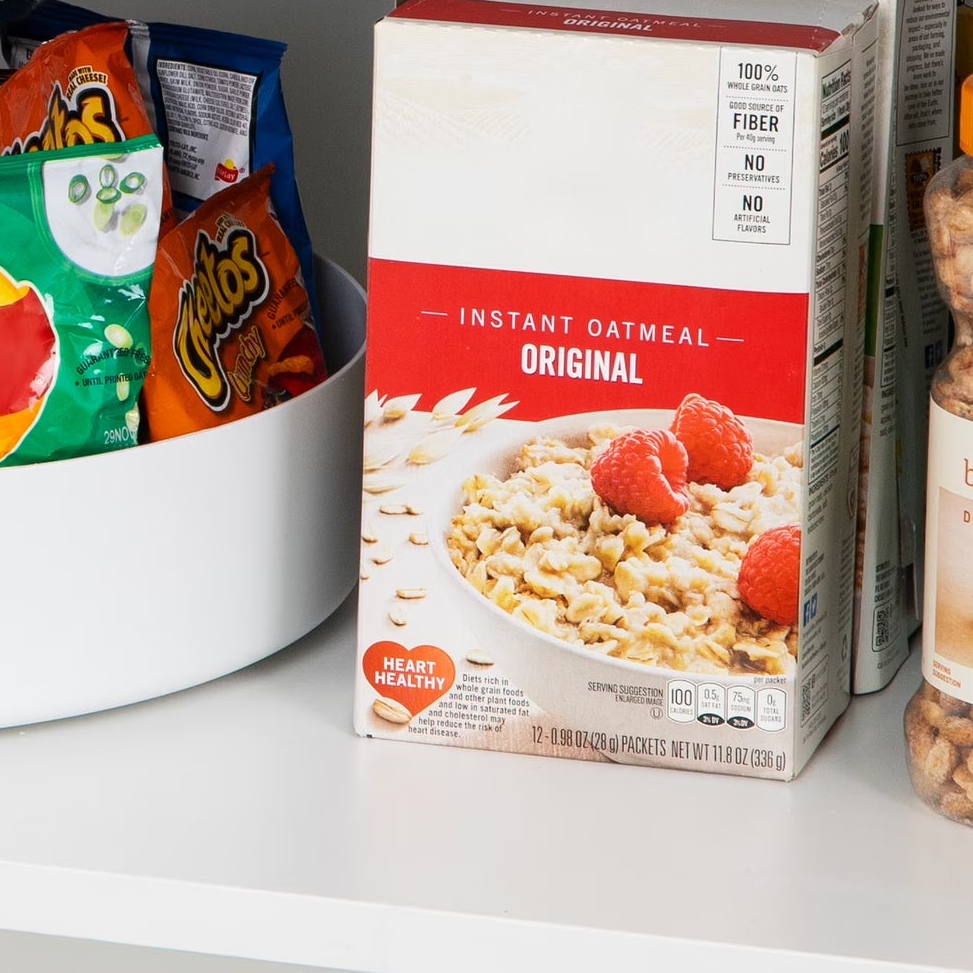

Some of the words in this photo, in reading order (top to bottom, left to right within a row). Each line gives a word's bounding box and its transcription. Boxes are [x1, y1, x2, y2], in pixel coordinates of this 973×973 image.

[528, 10, 611, 20] INSTANT
[617, 17, 703, 28] OATMEAL
[563, 18, 653, 32] ORIGINAL
[76, 72, 107, 86] CHEESE!
[738, 62, 779, 81] 100%
[727, 81, 749, 91] WHOLE
[750, 83, 771, 92] GRAIN
[772, 85, 788, 93] OATS
[729, 101, 747, 110] GOOD
[748, 102, 774, 112] SOURCE
[775, 104, 784, 113] OF
[733, 112, 779, 132] FIBER
[736, 132, 745, 141] Per
[746, 133, 756, 143] 40g
[757, 135, 775, 145] serving
[744, 153, 765, 171] NO
[727, 172, 780, 184] PRESERVATIVES
[742, 194, 763, 212] NO
[733, 213, 771, 224] ARTIFICIAL
[737, 224, 767, 234] FLAVORS
[175, 233, 266, 406] Cheetos
[459, 307, 574, 334] INSTANT
[587, 318, 710, 347] OATMEAL
[76, 347, 129, 375] GUARANTEED
[521, 343, 644, 385] ORIGINAL
[82, 377, 103, 387] UNTIL
[104, 374, 133, 384] PRINTED
[383, 656, 436, 675] HEART
[374, 671, 446, 691] HEALTHY
[462, 673, 482, 684] Diets
[484, 675, 499, 686] rich
[501, 677, 509, 686] in
[765, 675, 787, 685] packet
[932, 668, 962, 688] SUGGESTION
[455, 683, 479, 693] whole
[480, 685, 501, 696] grain
[502, 687, 524, 697] foods
[588, 681, 619, 694] SERVING
[619, 684, 664, 698] SUGGESTION
[704, 688, 720, 702] 0.5g
[449, 692, 463, 701] and
[464, 693, 485, 703] other
[487, 695, 507, 706] plant
[508, 697, 530, 708] foods
[615, 695, 645, 705] ENLARGED
[645, 697, 664, 707] IMAGE
[671, 688, 692, 707] 100
[732, 691, 750, 704] 75mg
[766, 693, 776, 707] 0g
[439, 701, 453, 709] and
[455, 702, 468, 710] low
[470, 703, 478, 711] in
[480, 704, 517, 716] saturated
[518, 707, 530, 717] fat
[669, 706, 693, 715] CALORIES
[763, 707, 779, 715] TOTAL
[428, 709, 443, 718] and
[444, 710, 488, 722] cholesterol
[490, 716, 506, 725] may
[408, 726, 428, 736] heart
[429, 727, 461, 738] disease.
[418, 717, 435, 727] help
[437, 719, 463, 729] reduce
[464, 721, 477, 730] the
[478, 722, 492, 732] risk
[494, 724, 503, 733] of
[531, 725, 543, 744] 12
[551, 728, 573, 747] 0.98
[575, 731, 589, 748] OZ
[590, 732, 608, 750] (28
[608, 734, 619, 754] g)
[621, 737, 667, 757] PACKETS
[671, 740, 691, 759] NET
[691, 742, 710, 761] WT
[712, 745, 732, 764] 11.8
[735, 747, 749, 766] OZ
[750, 749, 774, 769] (336
[775, 751, 786, 772] g)
